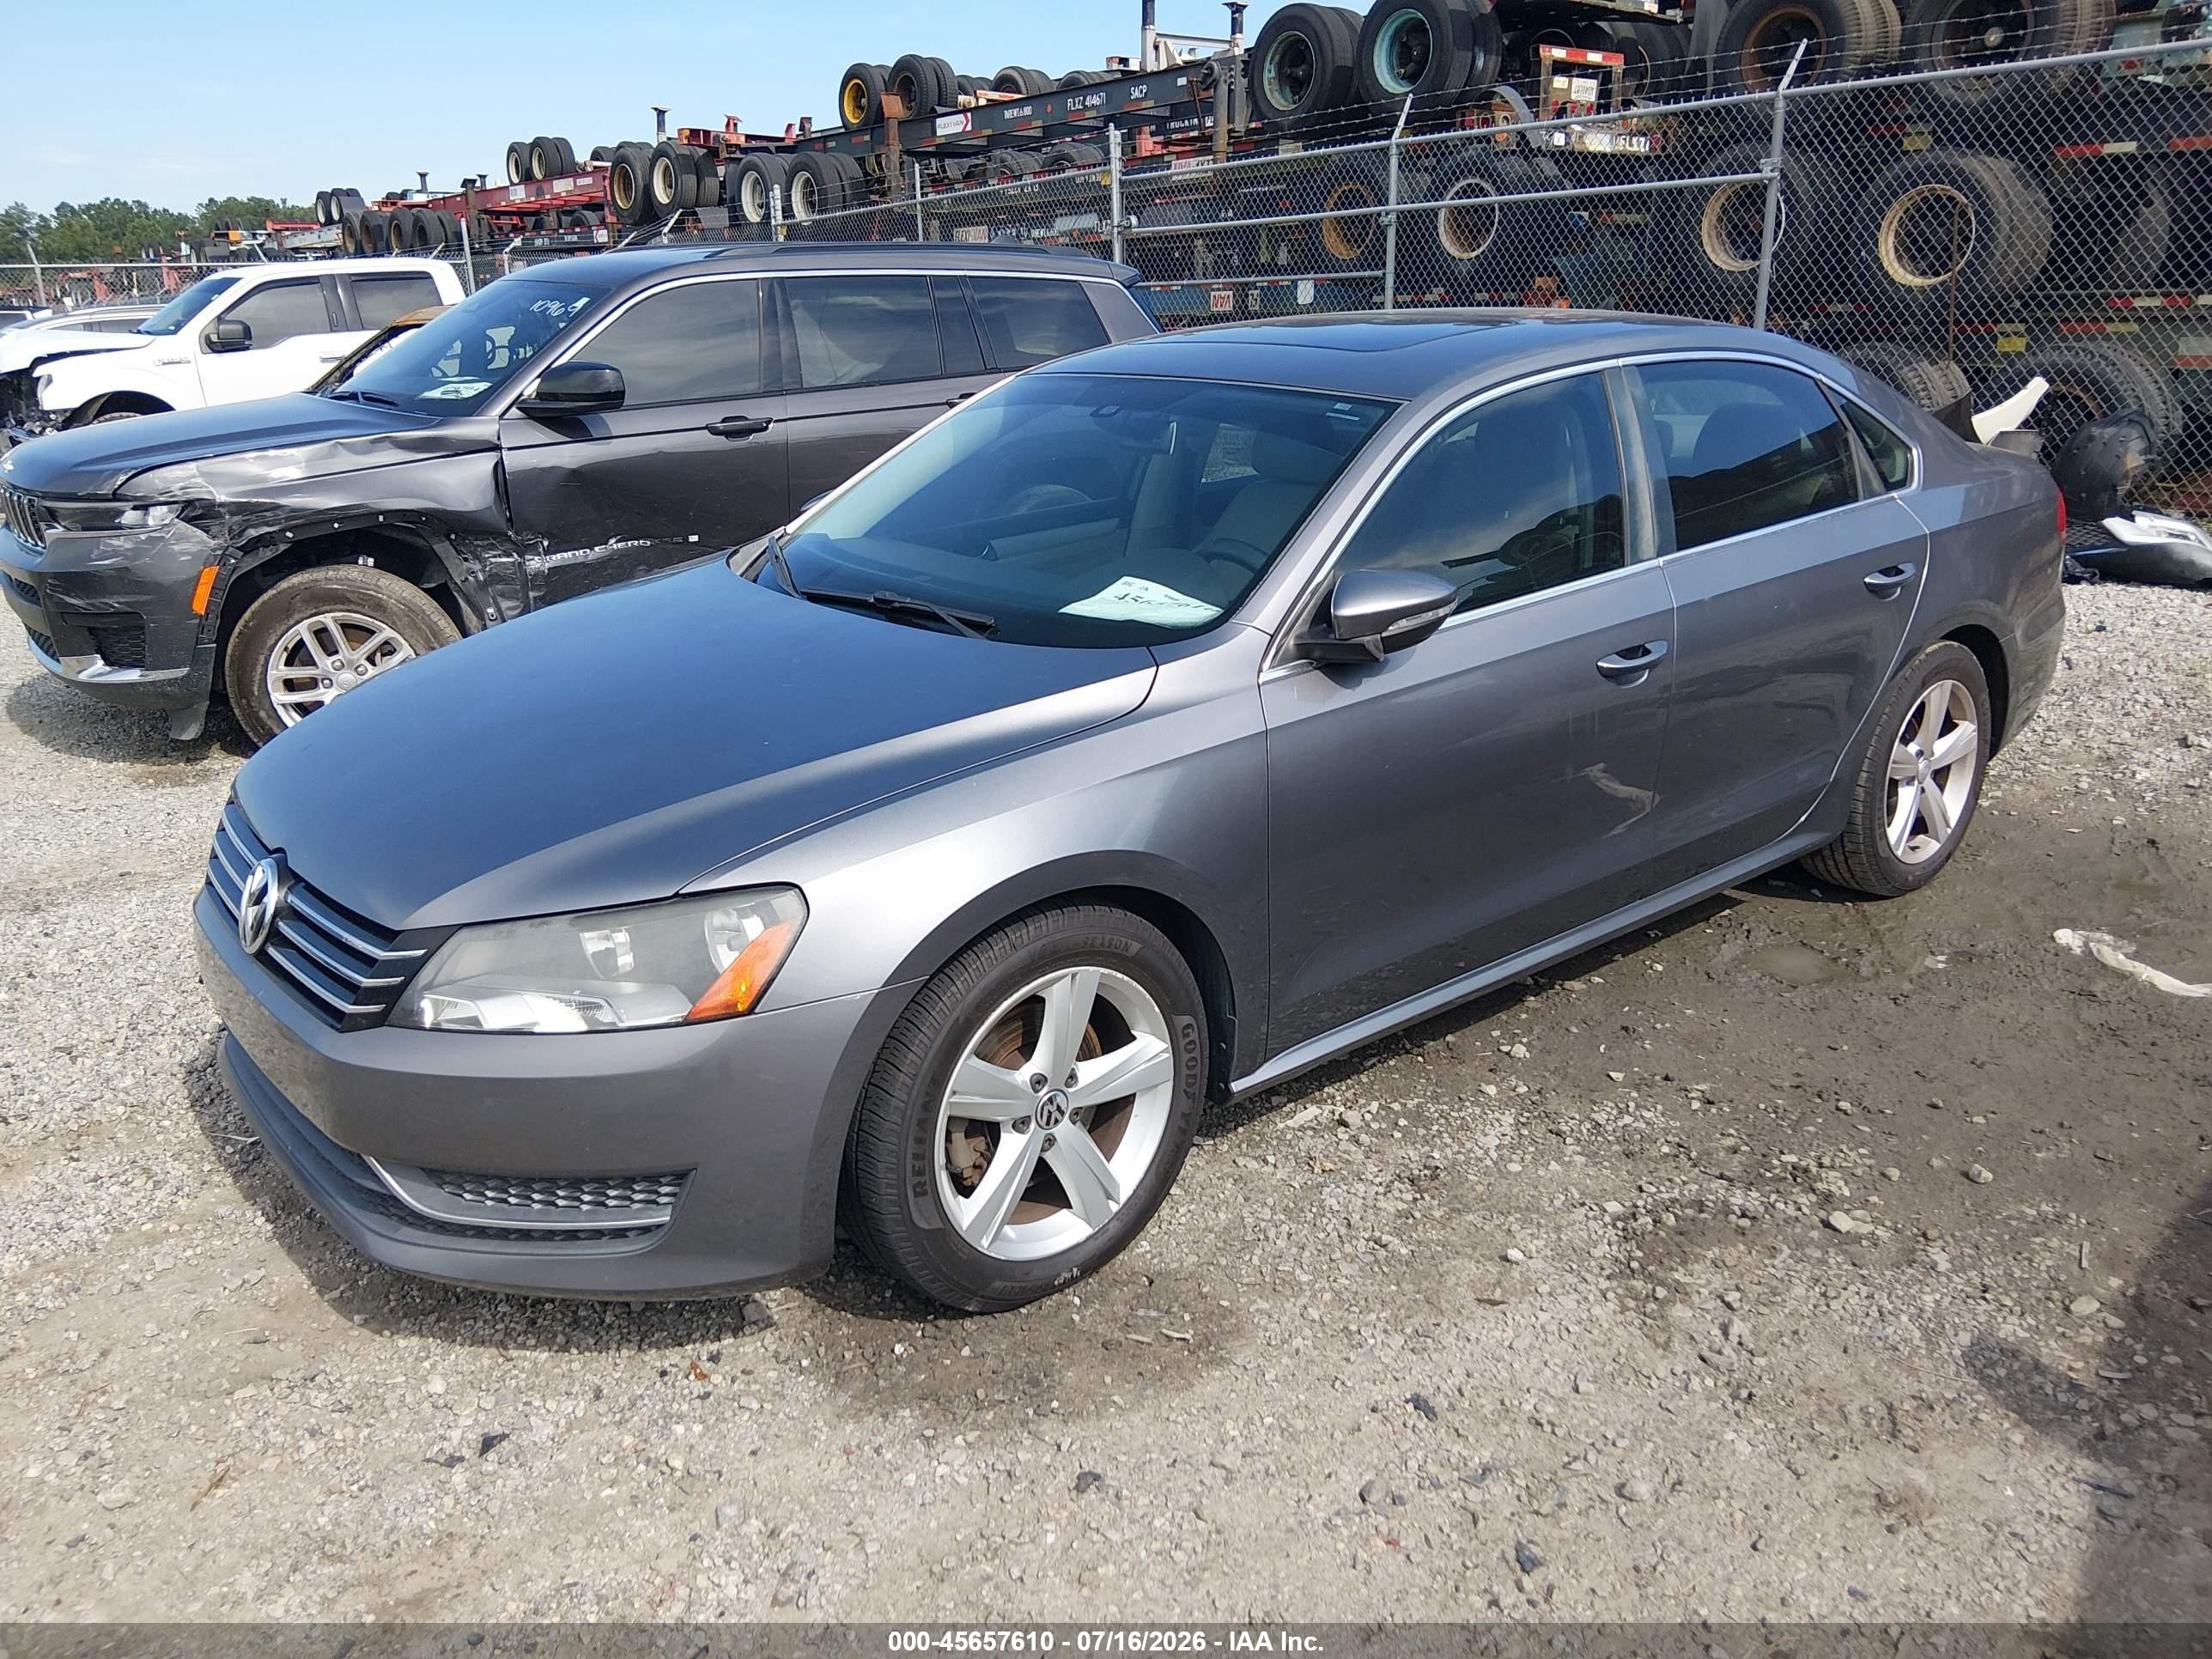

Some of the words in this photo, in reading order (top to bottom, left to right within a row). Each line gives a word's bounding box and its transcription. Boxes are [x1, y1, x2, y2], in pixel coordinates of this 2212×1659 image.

[1130, 85, 1147, 100] SACP
[1066, 95, 1085, 112] FLXZ
[1085, 92, 1106, 108] 414671
[1094, 217, 1112, 234] FLX
[1212, 293, 1231, 308] VAN
[534, 548, 592, 563] GRAND
[1170, 1022, 1200, 1152] GOODY
